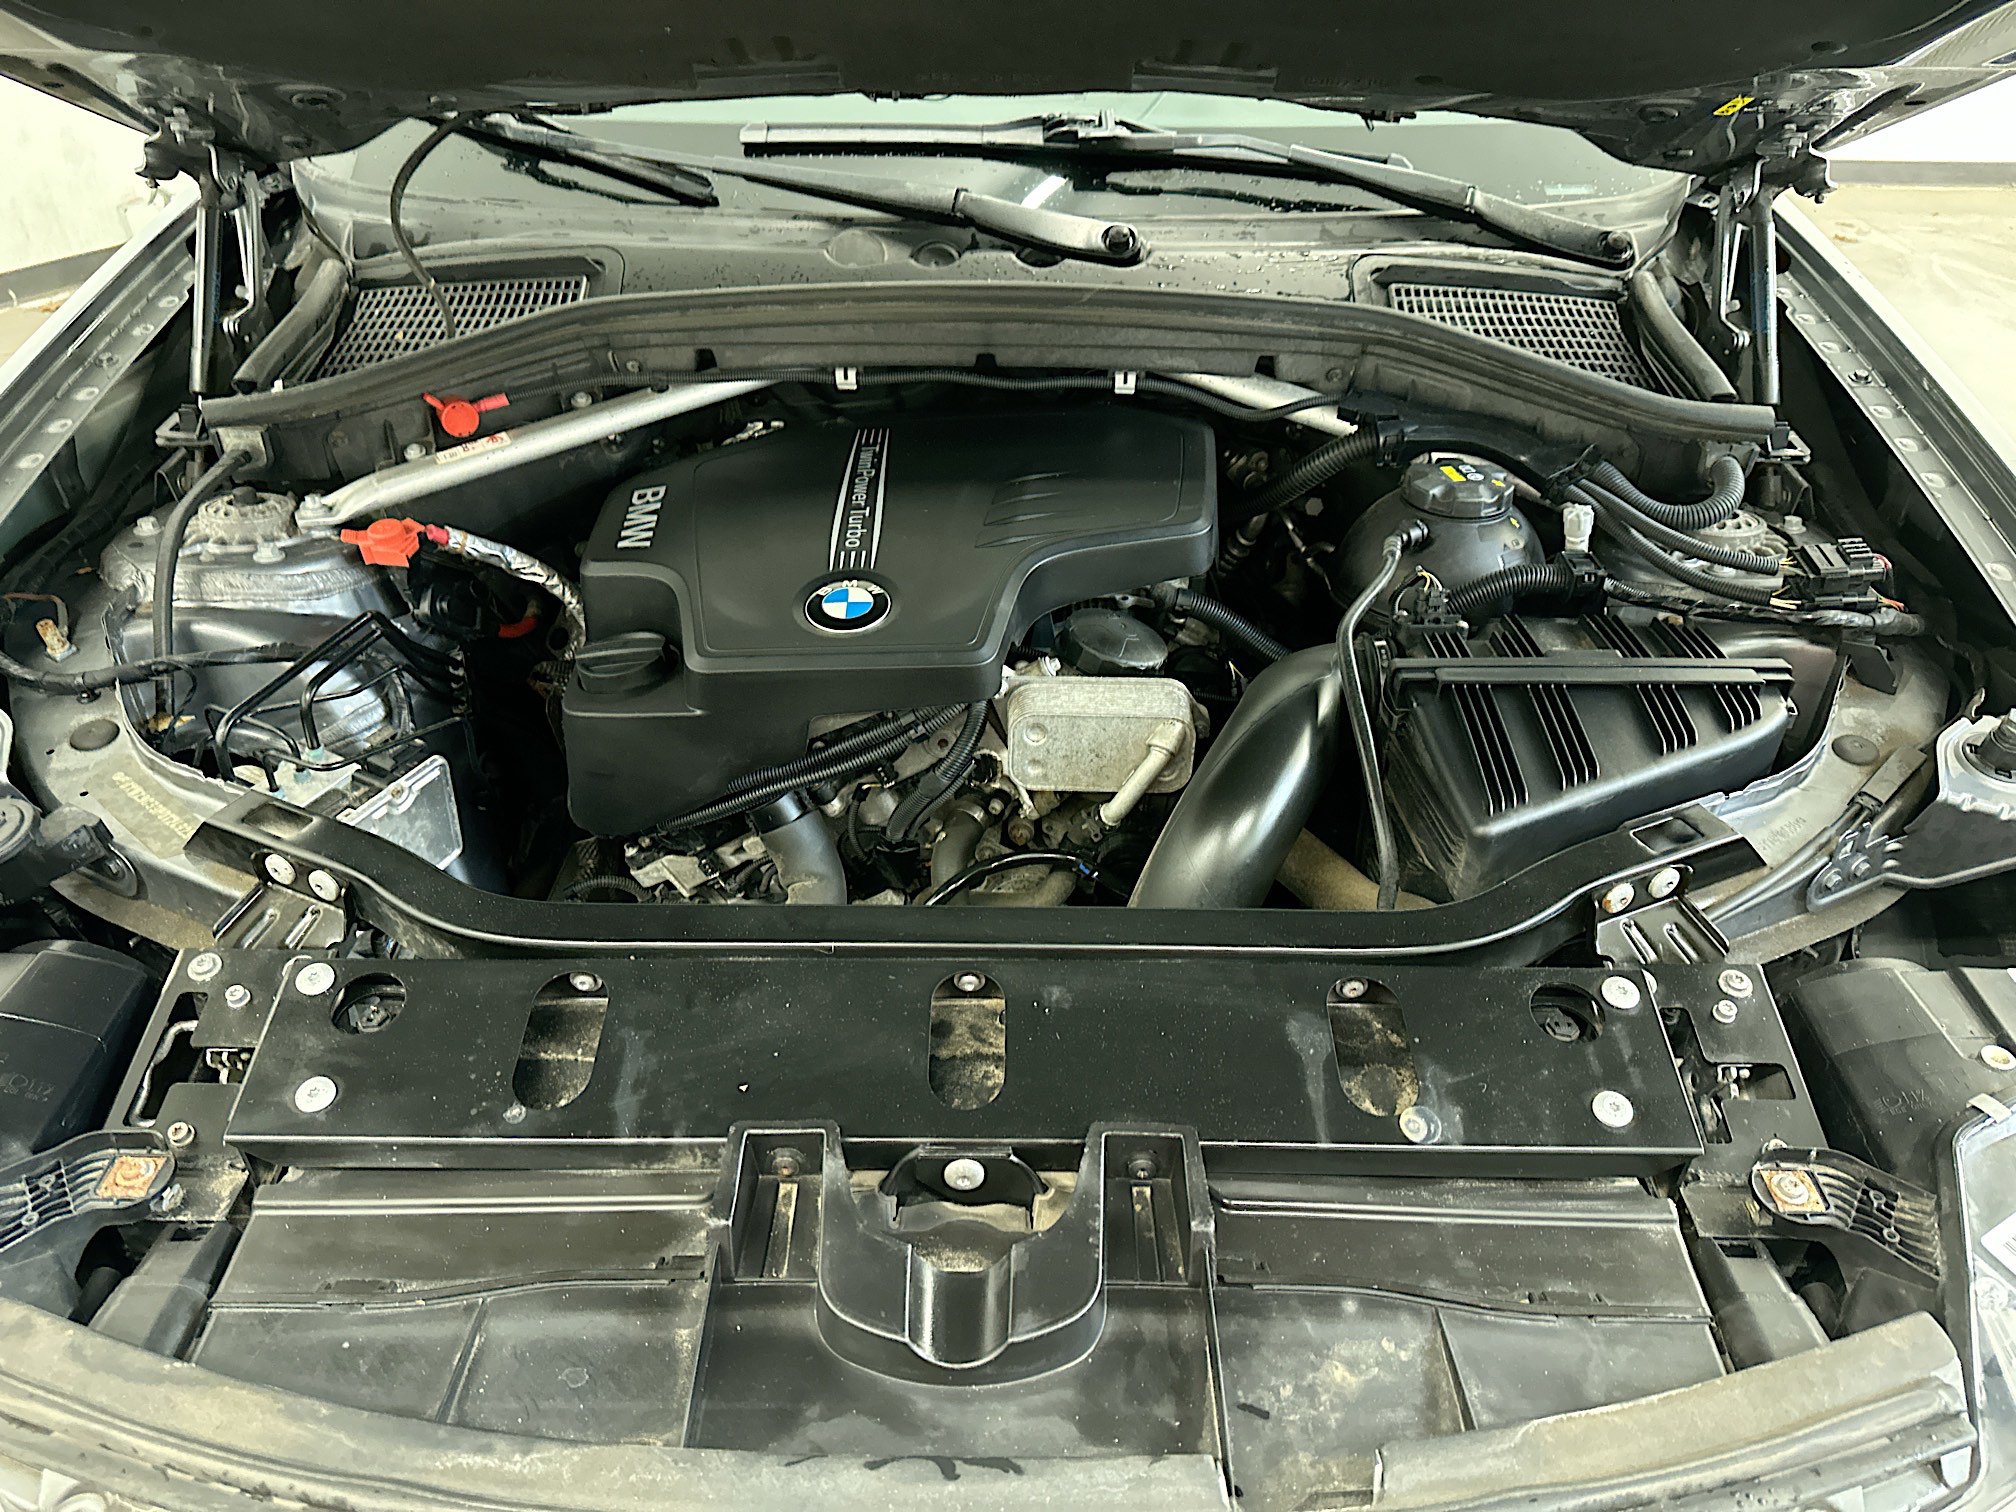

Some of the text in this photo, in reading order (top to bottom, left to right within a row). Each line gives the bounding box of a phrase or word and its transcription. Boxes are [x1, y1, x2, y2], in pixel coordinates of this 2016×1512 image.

[617, 485, 667, 549] BMW
[845, 443, 880, 549] TwinPower Turbo
[817, 579, 885, 597] BMW
